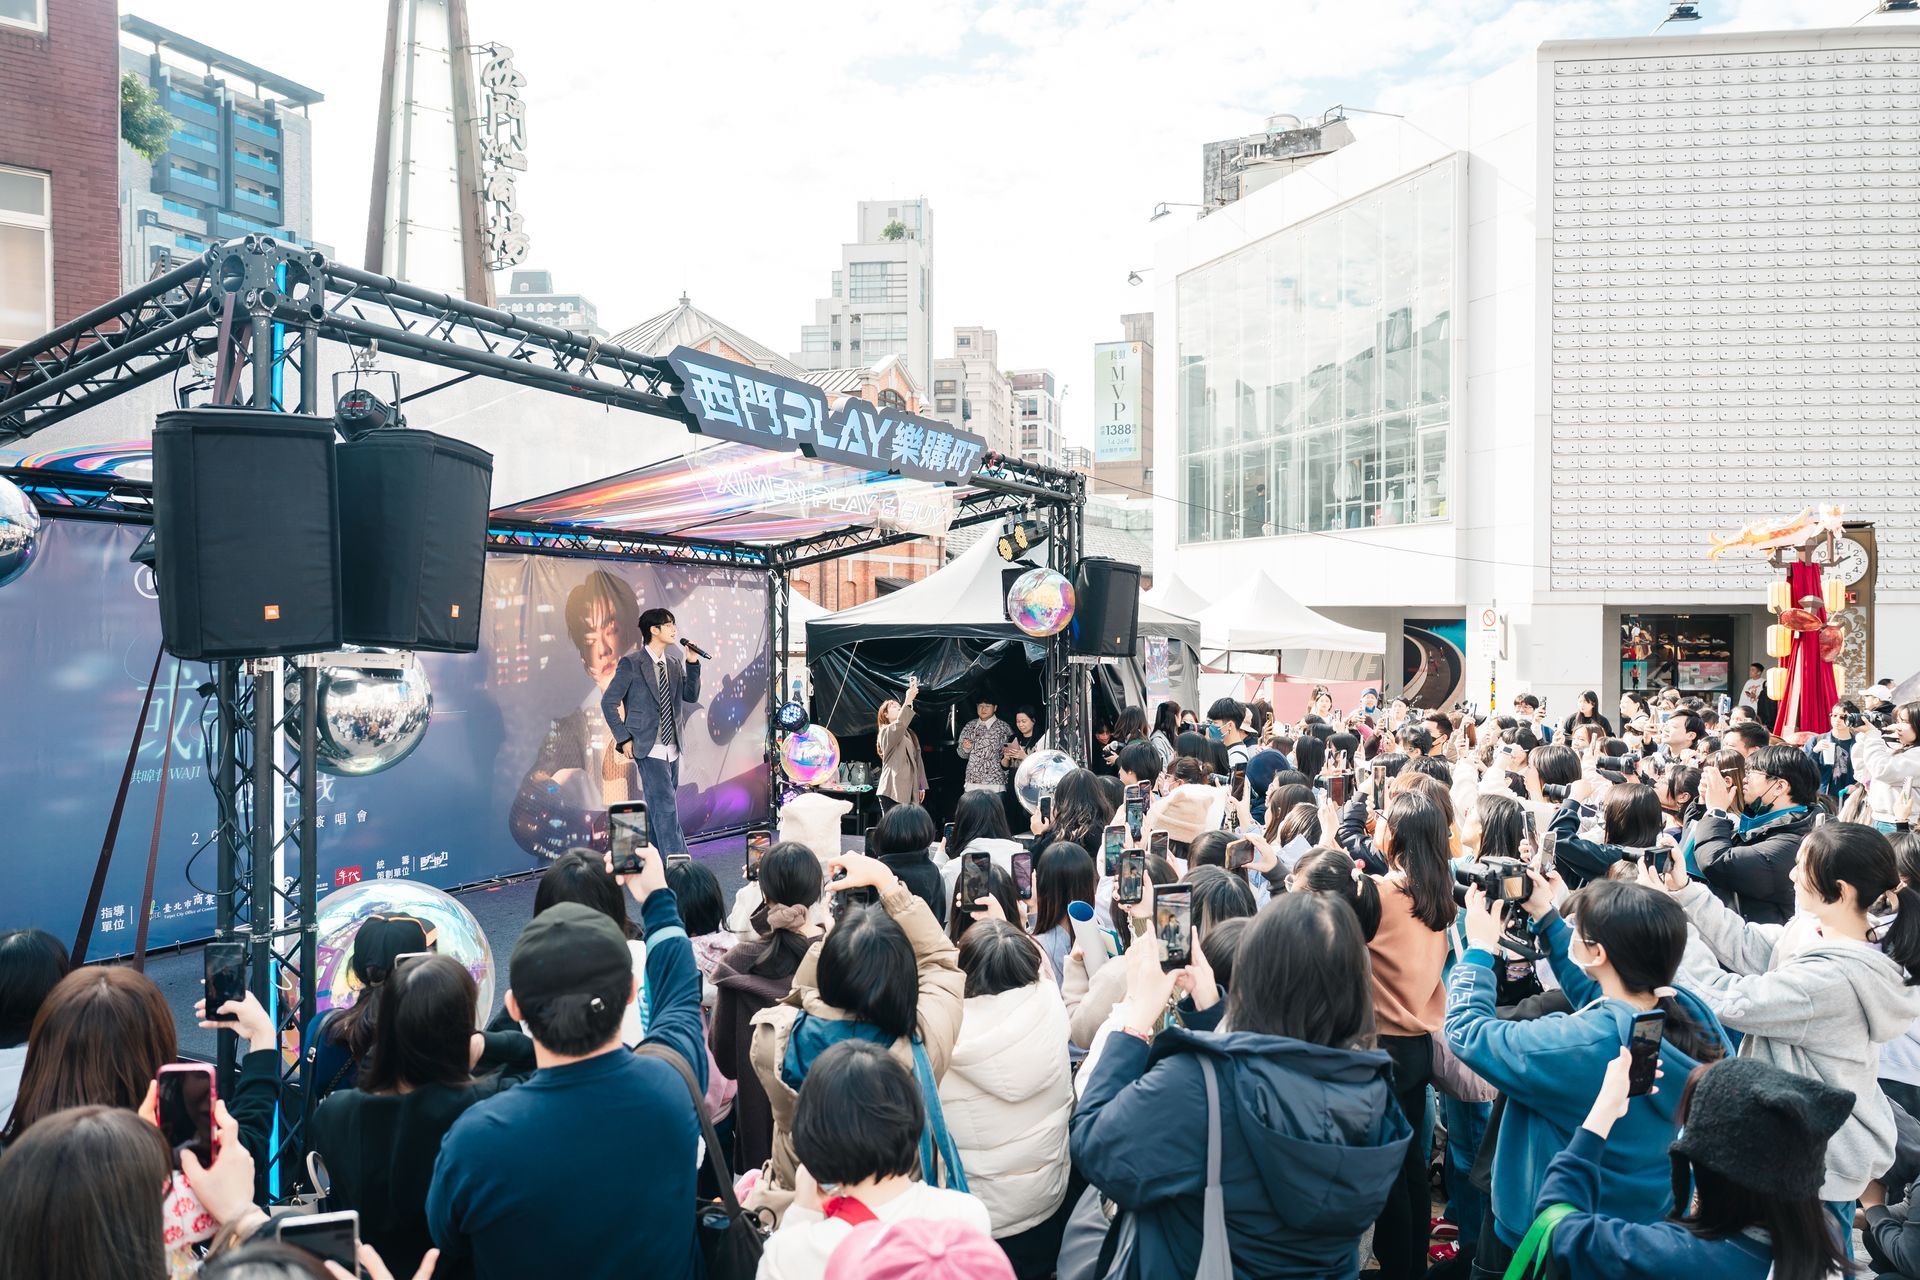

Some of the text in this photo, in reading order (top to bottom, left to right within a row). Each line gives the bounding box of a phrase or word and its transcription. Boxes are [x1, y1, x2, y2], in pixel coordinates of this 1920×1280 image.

[1110, 365, 1126, 421] MVP
[1105, 424, 1132, 436] 1388
[715, 470, 808, 507] XIMEN
[811, 484, 880, 517] PLAY
[900, 501, 950, 525] BUY
[1301, 648, 1381, 681] NIKE
[100, 905, 125, 919] 指導
[100, 919, 125, 932] 單位
